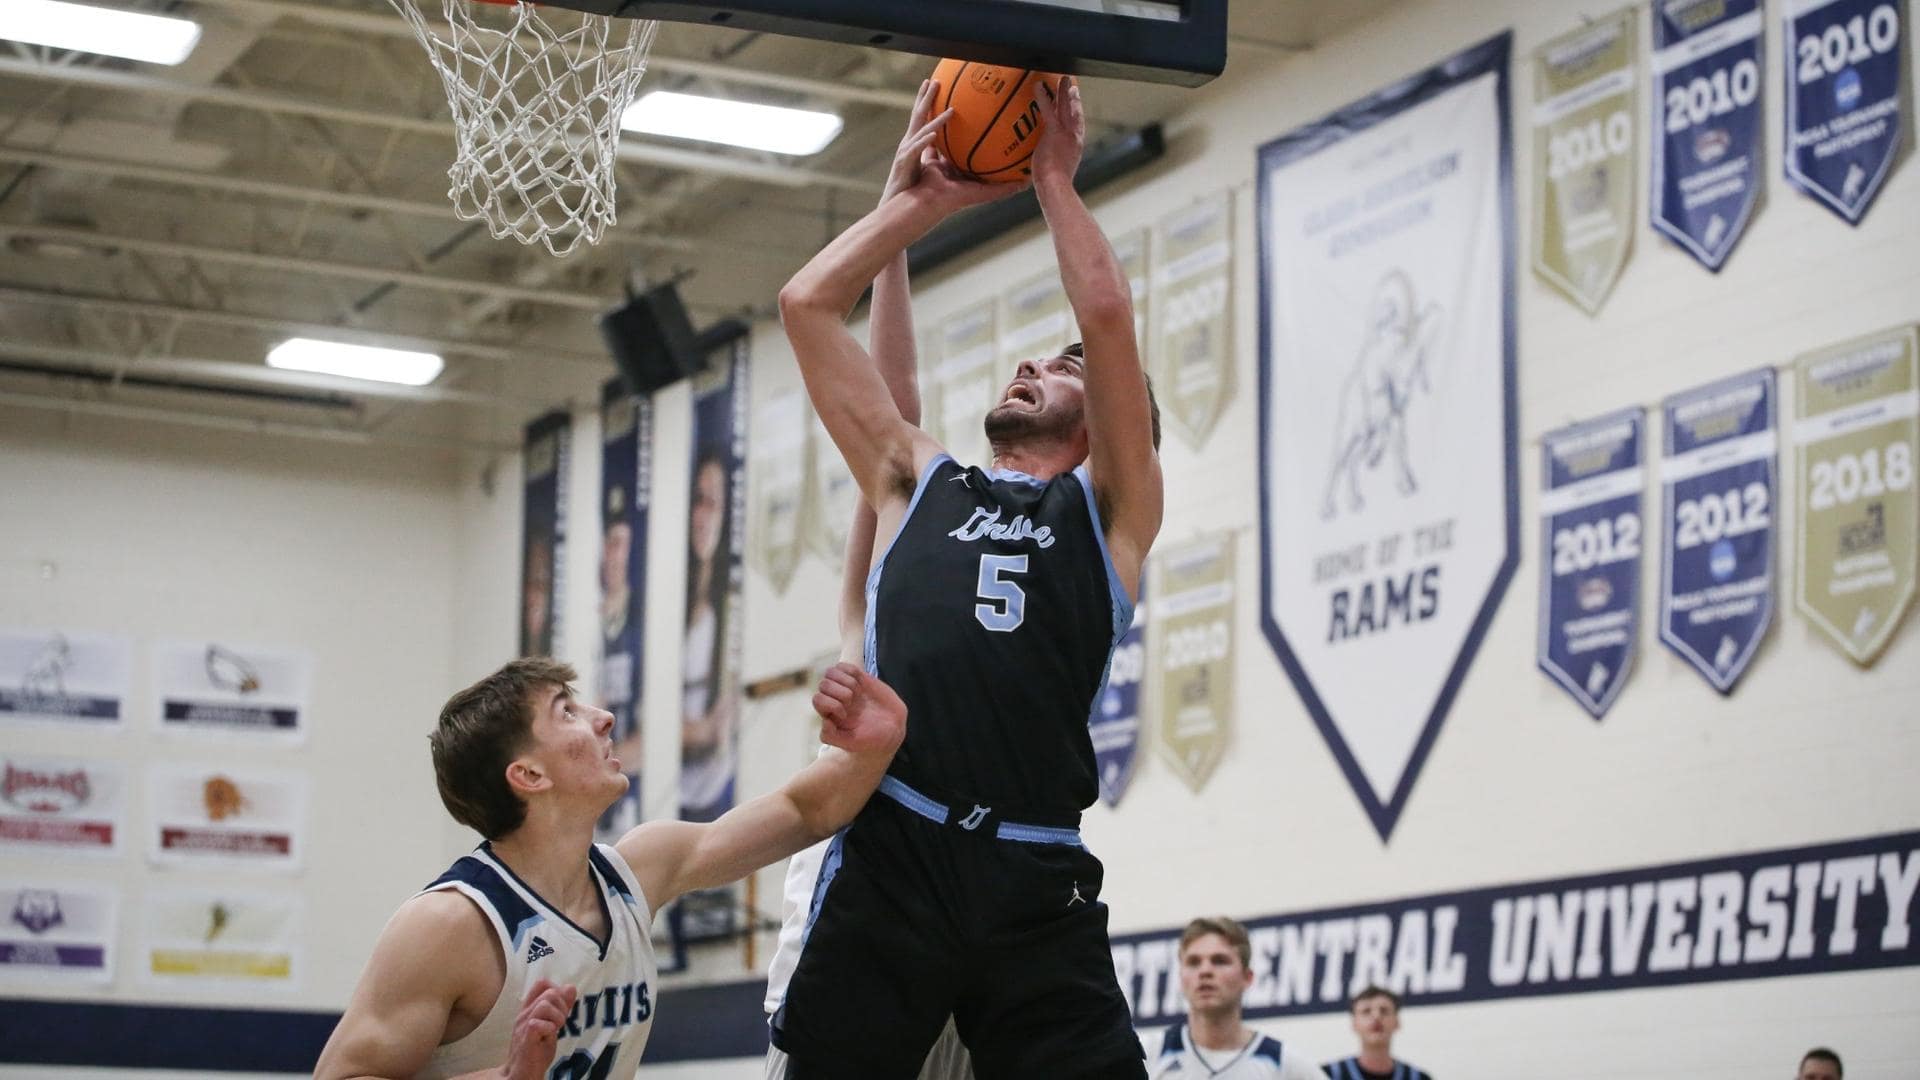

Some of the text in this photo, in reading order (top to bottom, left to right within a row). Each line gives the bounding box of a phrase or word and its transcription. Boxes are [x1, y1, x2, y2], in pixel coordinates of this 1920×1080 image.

[1798, 4, 1899, 84] 2010
[1666, 58, 1759, 134] 2010
[1550, 111, 1631, 178] 2010
[1810, 441, 1912, 510] 2018
[1553, 512, 1641, 576] 2012
[1675, 481, 1770, 550] 2012
[975, 553, 1029, 632] 5
[1327, 565, 1440, 644] RAMS
[1246, 905, 1467, 1006] ENTRAL
[1489, 850, 1920, 987] UNIVERSITY
